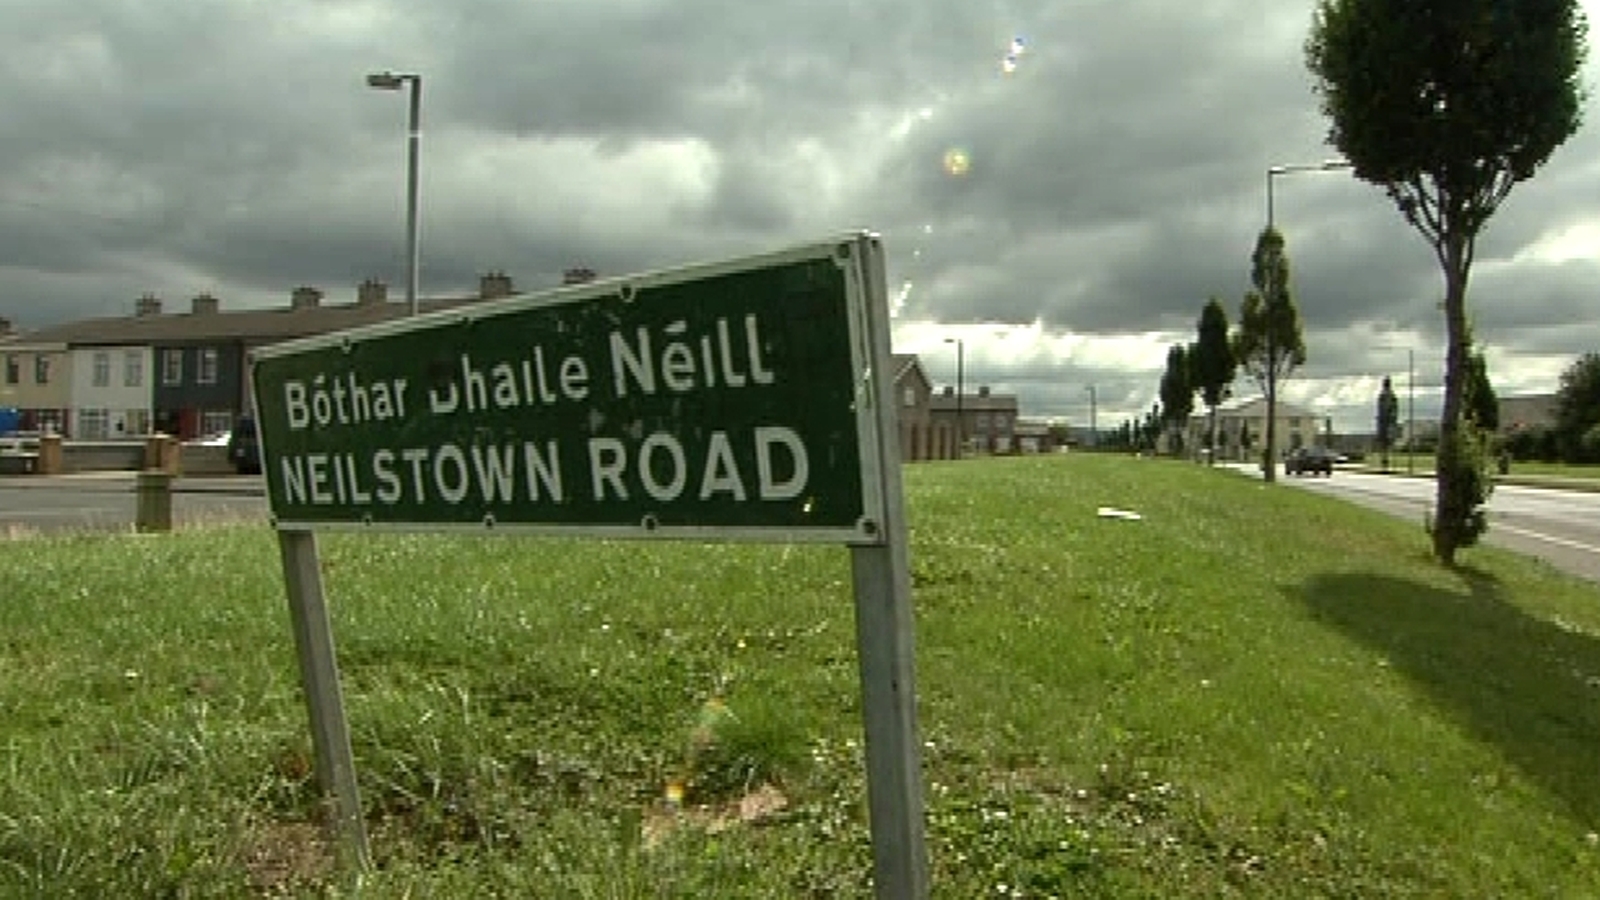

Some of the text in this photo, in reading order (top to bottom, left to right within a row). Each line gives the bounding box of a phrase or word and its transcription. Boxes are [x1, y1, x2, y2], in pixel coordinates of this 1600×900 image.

[284, 371, 407, 429] Bóthar
[609, 314, 775, 398] Néill
[281, 426, 810, 504] NEILSTOWN ROAD
